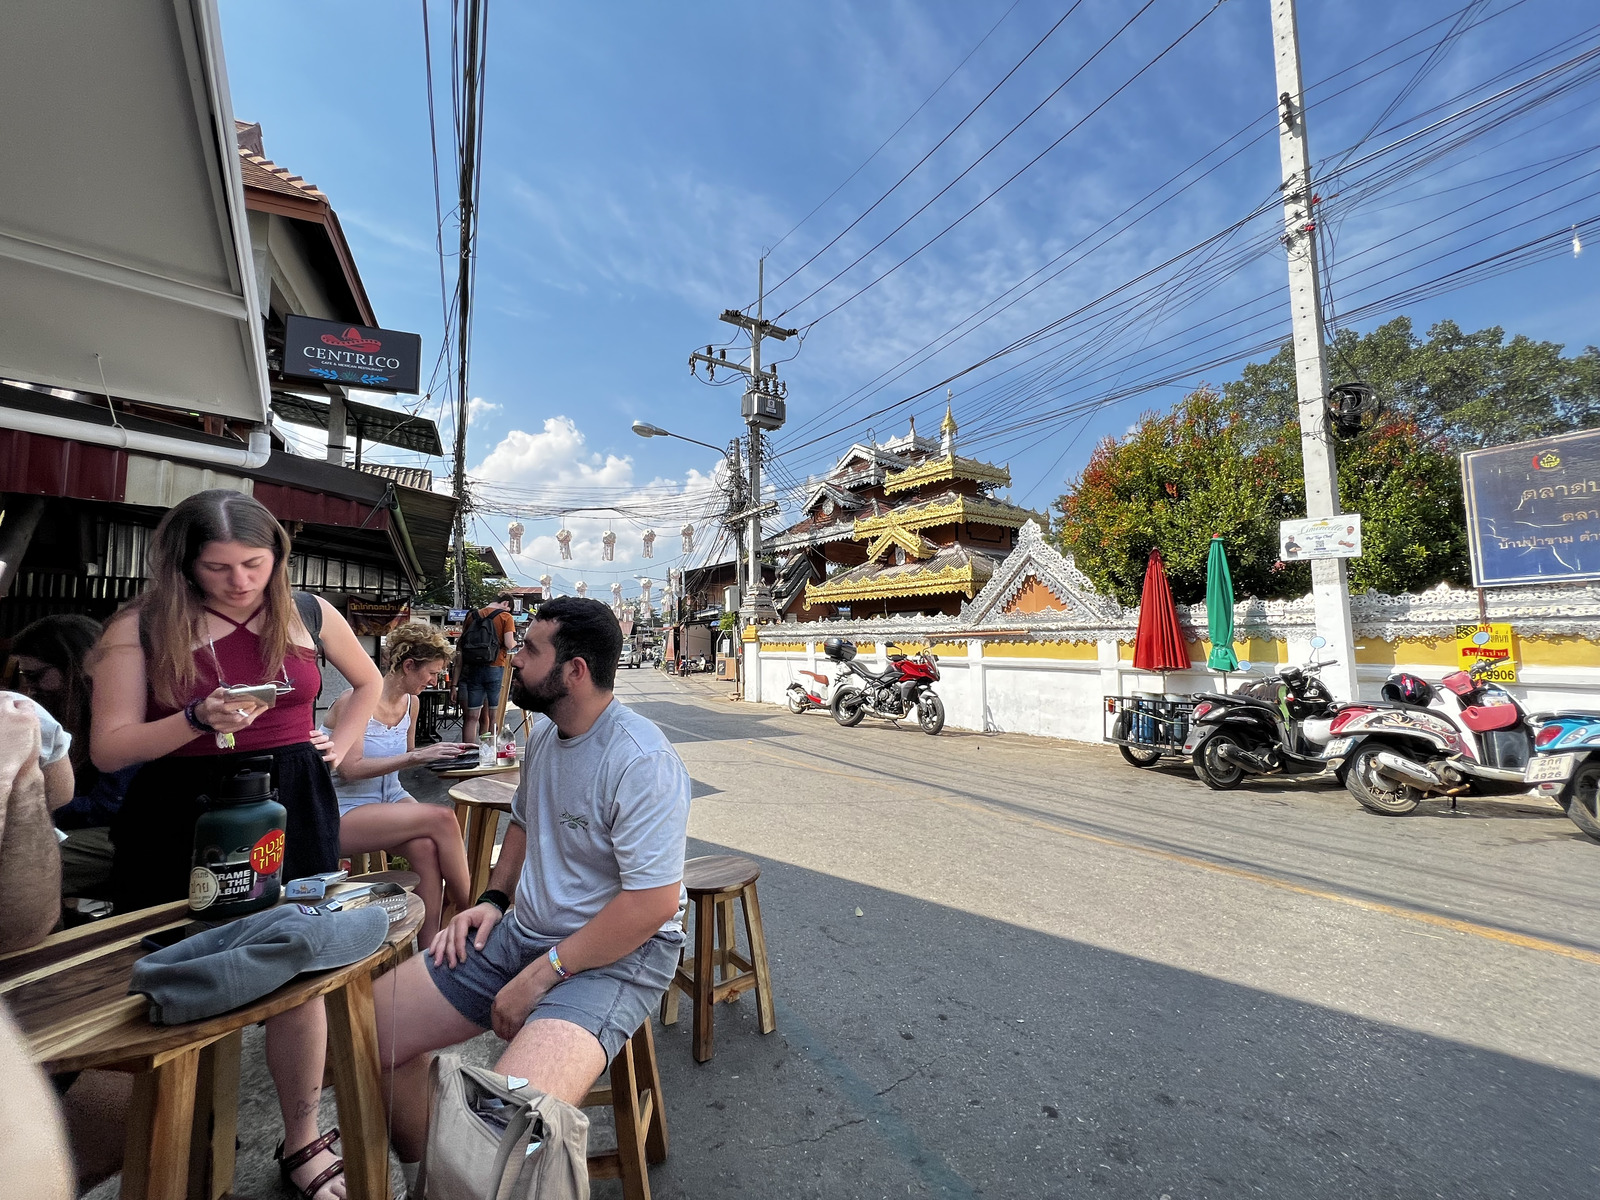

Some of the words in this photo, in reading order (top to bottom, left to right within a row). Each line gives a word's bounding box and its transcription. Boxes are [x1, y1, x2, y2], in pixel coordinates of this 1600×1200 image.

[303, 346, 400, 369] CENTRICO
[1532, 771, 1562, 780] 4926
[253, 833, 285, 860] סנטה
[259, 847, 283, 870] קרוז
[218, 884, 250, 896] LBUM
[227, 877, 250, 887] THE
